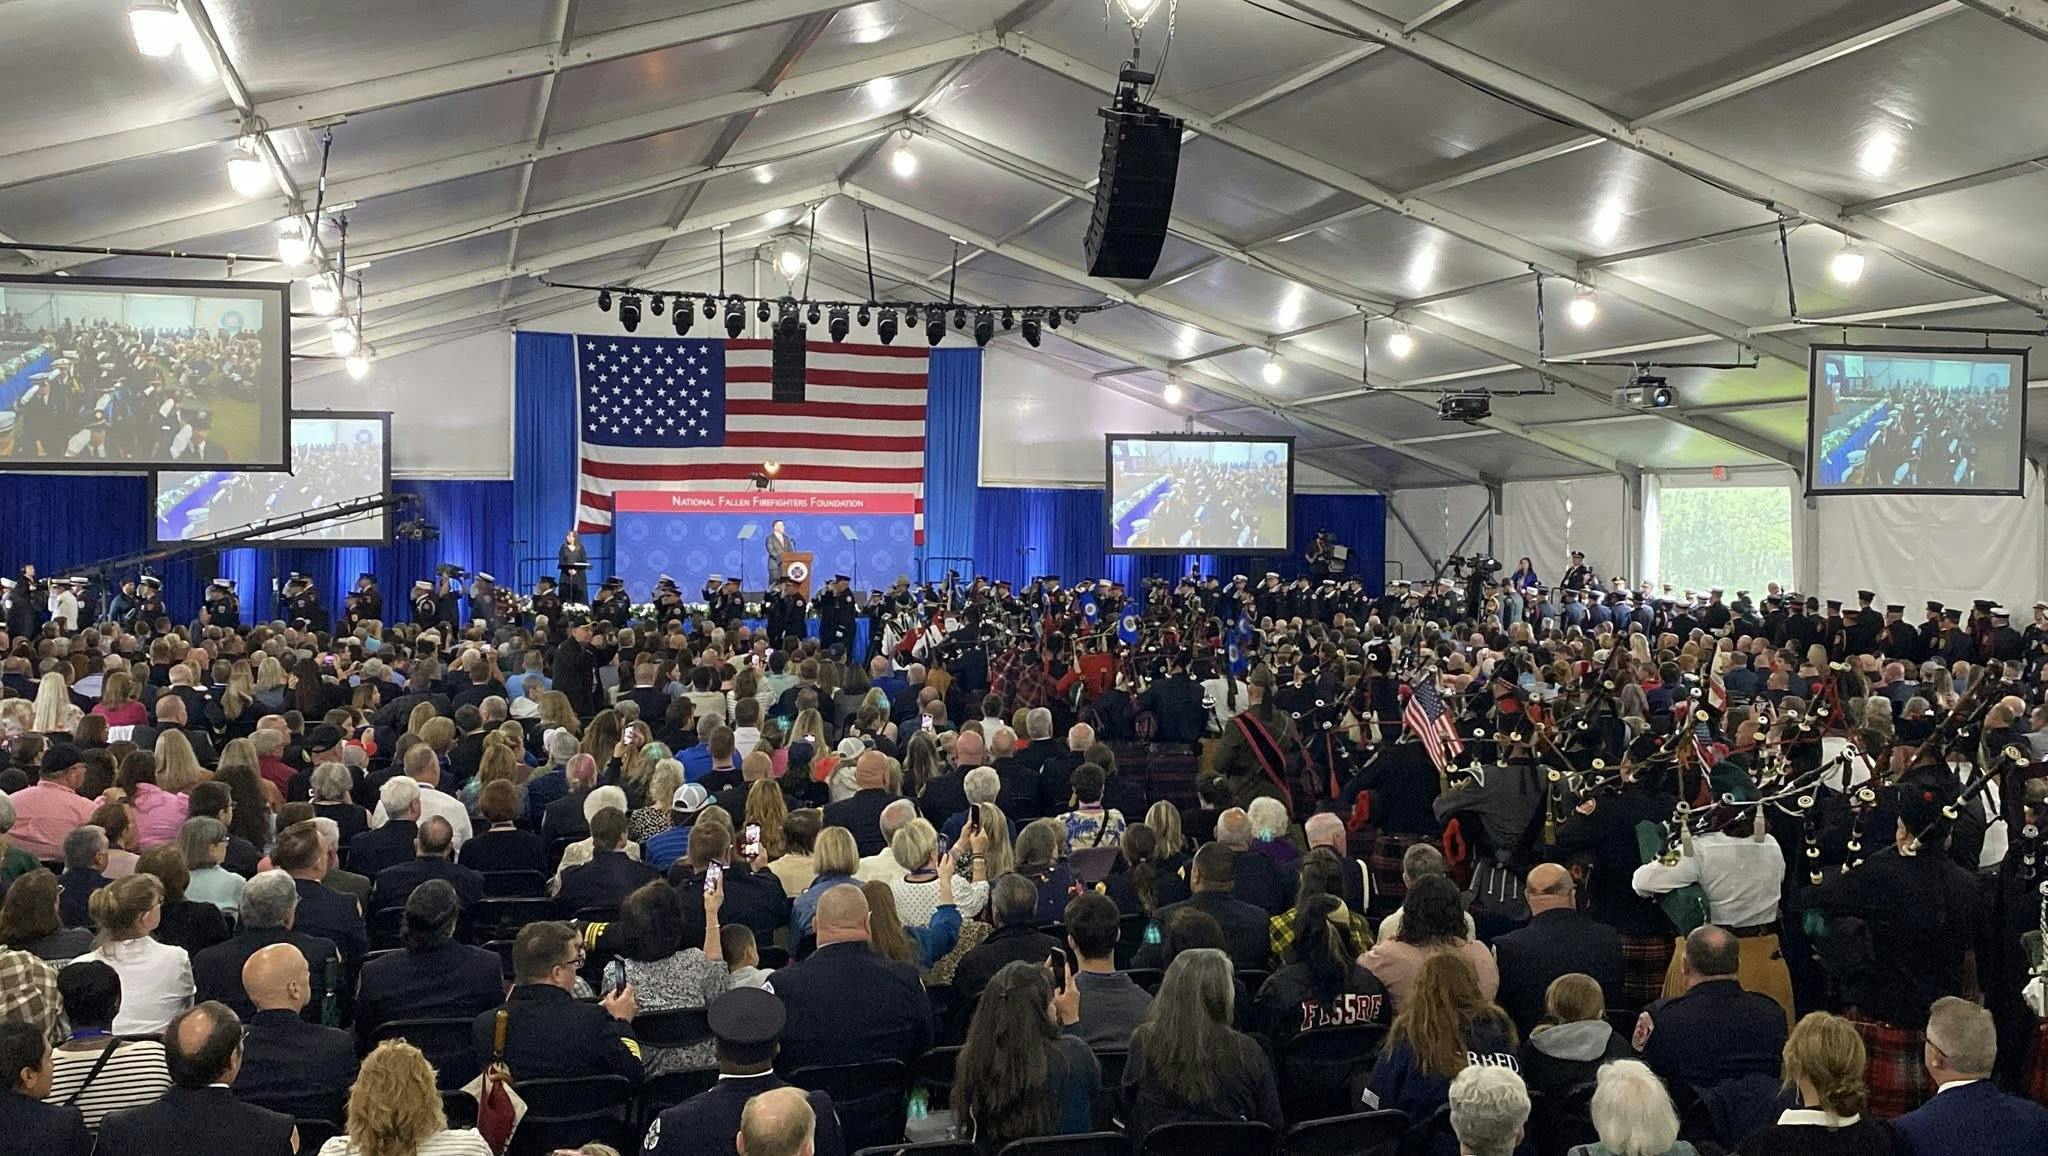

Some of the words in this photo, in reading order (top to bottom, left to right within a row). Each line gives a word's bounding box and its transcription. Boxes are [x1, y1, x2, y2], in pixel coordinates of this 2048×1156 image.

[672, 495, 714, 506] NATIONAL
[718, 496, 749, 506] FALLEN
[753, 496, 808, 507] FIREFIGHTERS
[810, 497, 864, 507] FOUNDATION
